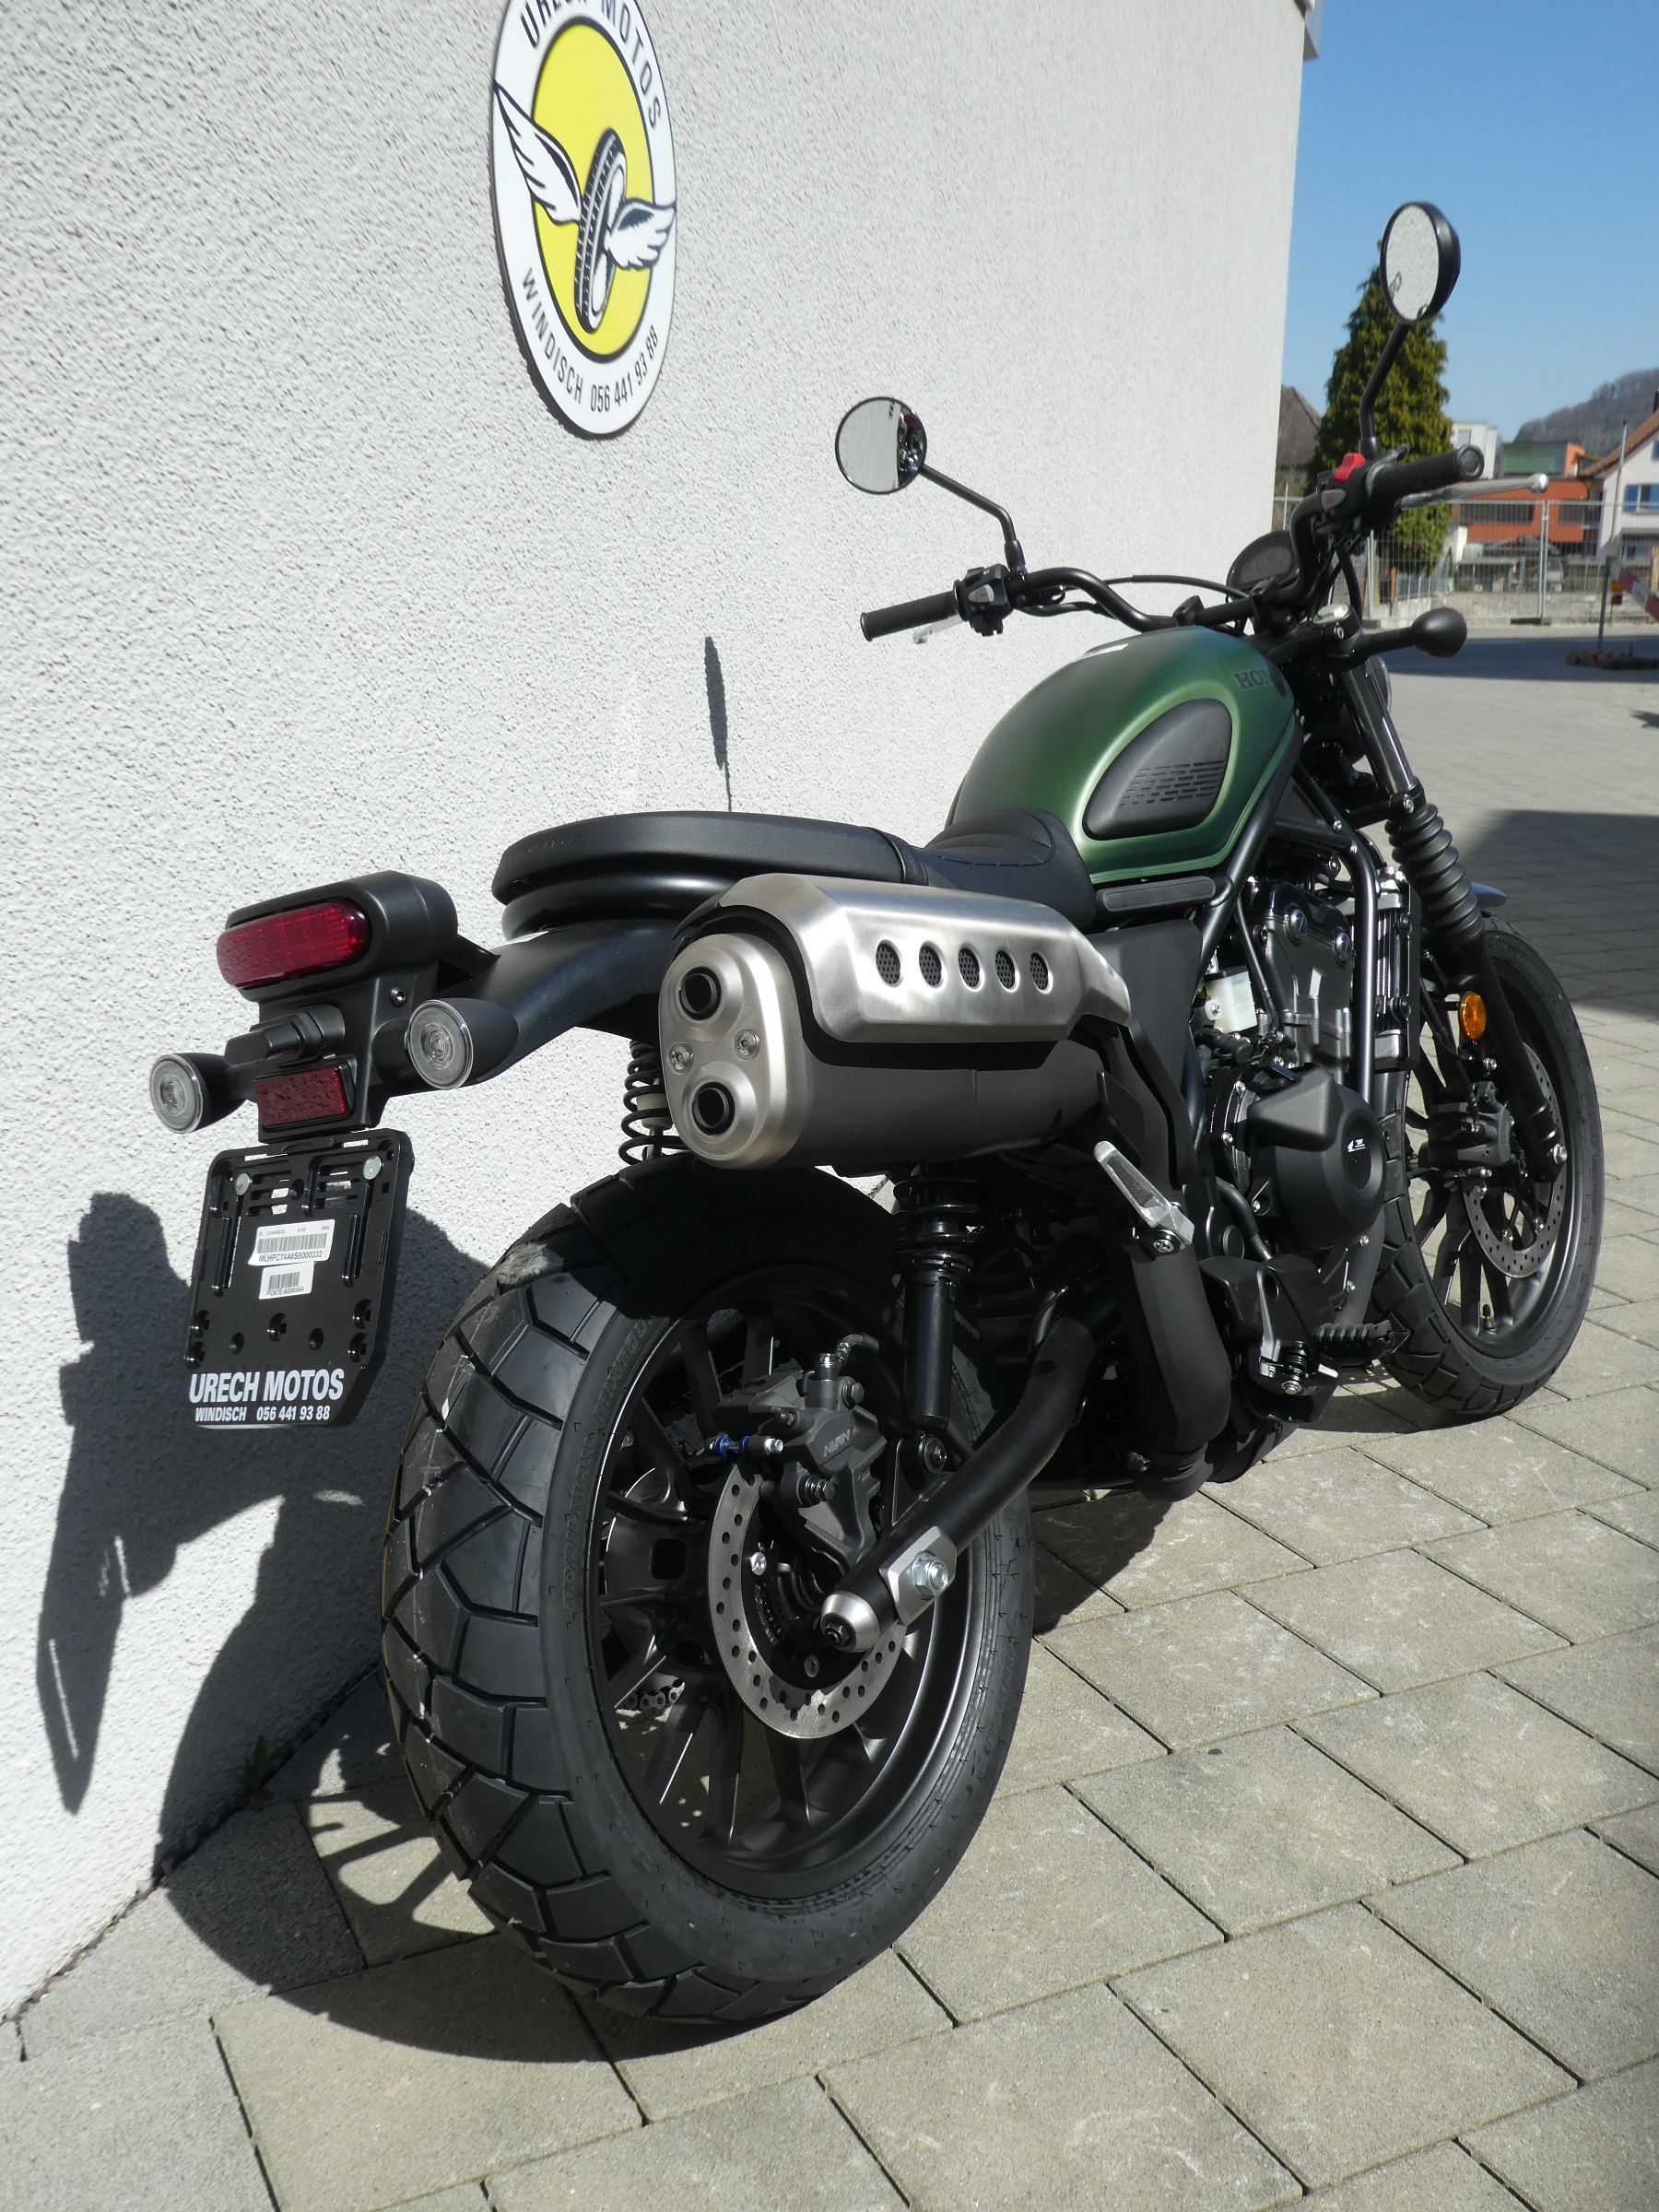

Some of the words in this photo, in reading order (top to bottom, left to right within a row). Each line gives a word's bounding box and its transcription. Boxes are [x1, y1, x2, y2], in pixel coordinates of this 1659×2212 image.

[523, 266, 584, 404] WINDISCH
[590, 383, 610, 412] 056
[614, 372, 633, 407] 441
[634, 353, 648, 386] 93
[646, 324, 658, 360] 88
[1231, 669, 1274, 690] HON
[189, 1371, 261, 1403] URECH
[263, 1368, 345, 1402] MOTOS
[593, 1315, 653, 1425] MIXTOU
[195, 1406, 248, 1422] WINDISCH
[256, 1406, 276, 1421] 056
[278, 1406, 297, 1421] 441
[300, 1406, 314, 1420] 93
[316, 1405, 331, 1420] 88
